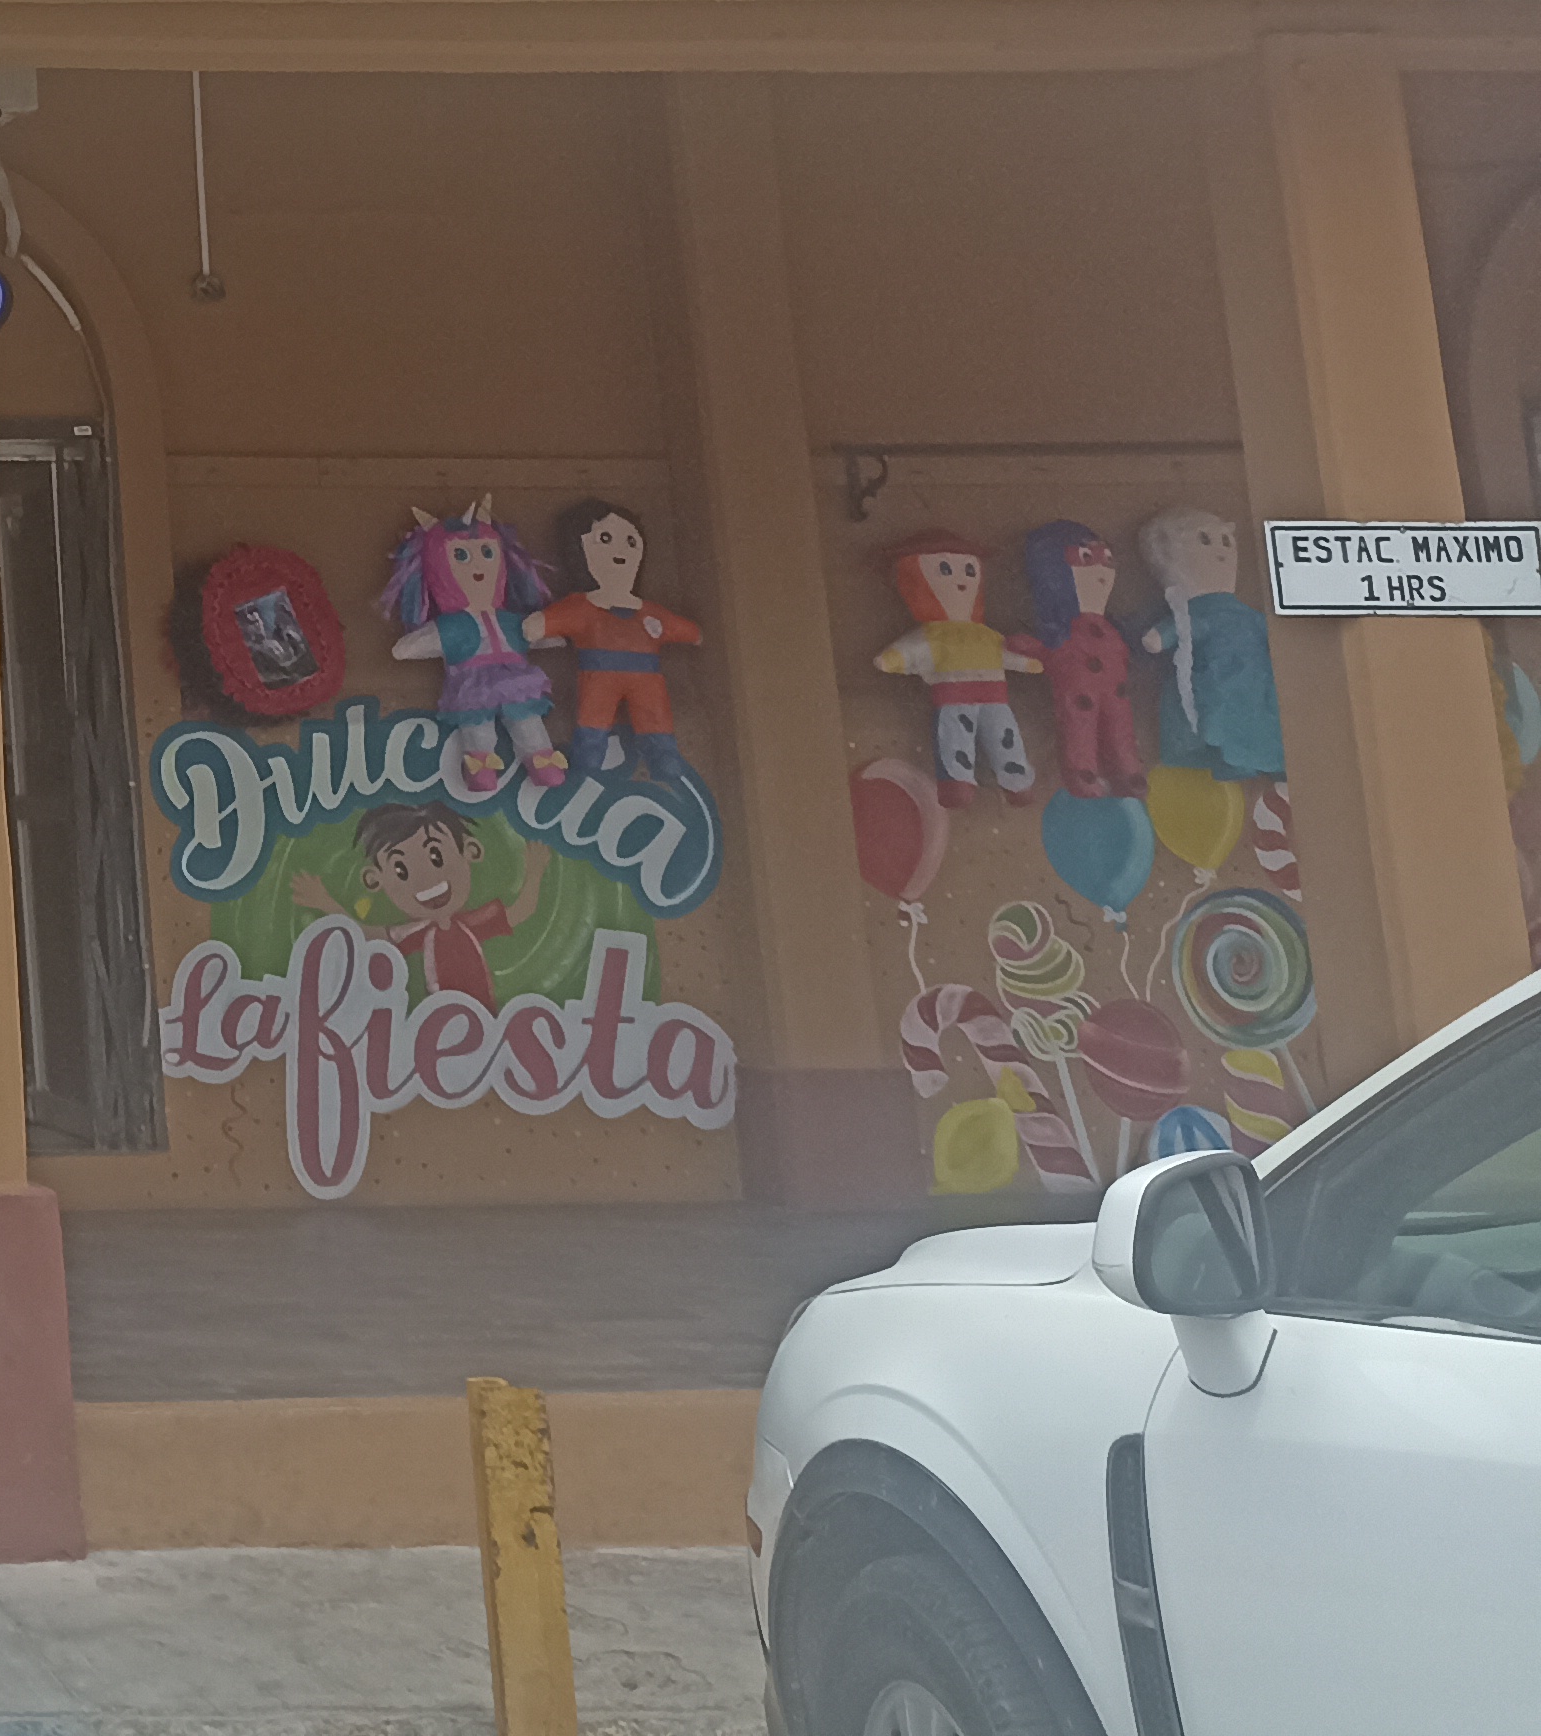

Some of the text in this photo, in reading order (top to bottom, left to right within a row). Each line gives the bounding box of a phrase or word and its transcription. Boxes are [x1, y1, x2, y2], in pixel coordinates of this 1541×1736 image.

[1410, 535, 1525, 564] MAXIMO
[1386, 574, 1448, 603] HRS
[162, 924, 732, 1189] La fiesta
